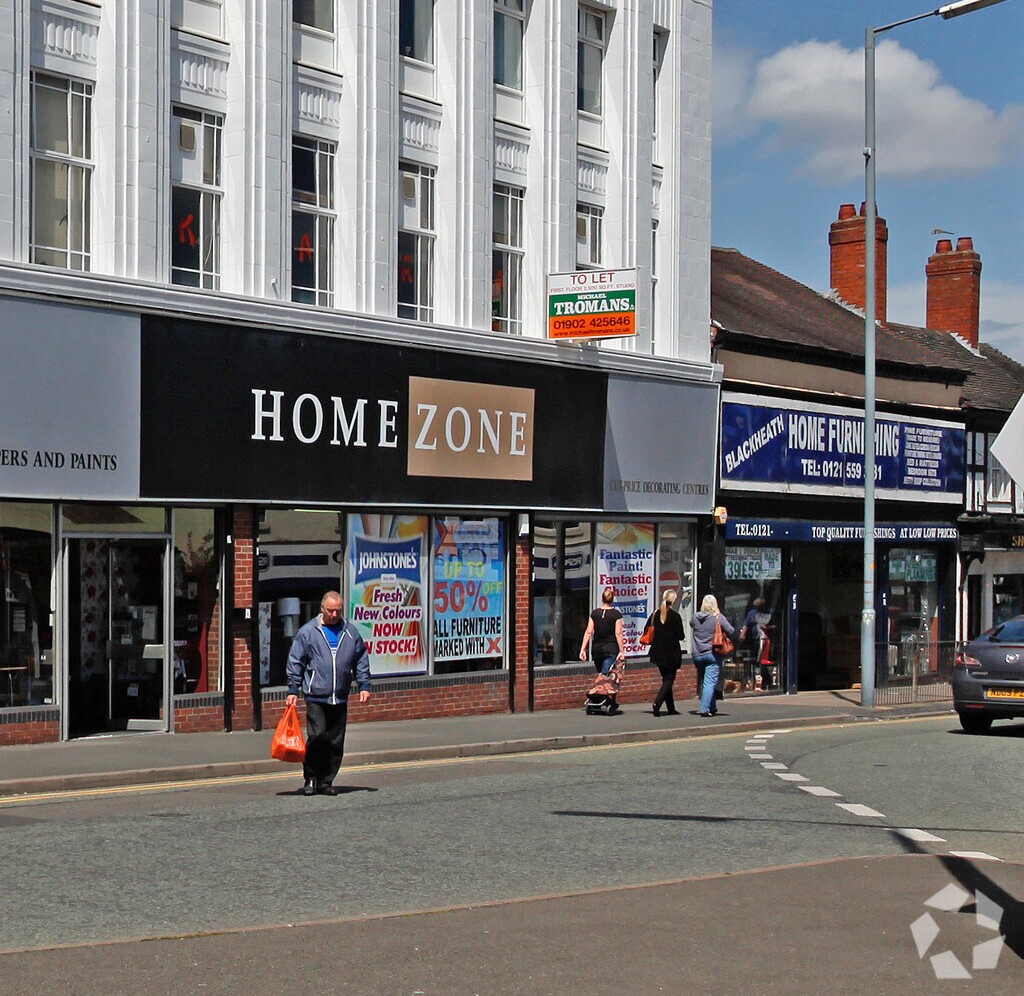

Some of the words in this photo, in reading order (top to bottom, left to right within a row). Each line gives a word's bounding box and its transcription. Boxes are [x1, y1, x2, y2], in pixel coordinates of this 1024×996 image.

[570, 274, 587, 285] TO
[592, 272, 615, 284] LET
[553, 319, 586, 330] 01902
[590, 316, 631, 328] 425646
[251, 388, 398, 448] HOME
[414, 403, 526, 456] ZONE
[725, 414, 785, 473] BLACKHEATH
[788, 414, 825, 452] HOME
[828, 418, 899, 458] FURNIHING
[33, 451, 65, 468] AND
[71, 453, 117, 471] PAINTS
[801, 459, 821, 477] TEL:
[822, 460, 842, 477] 0121
[846, 462, 862, 479] 559
[643, 481, 681, 494] DECORATING
[683, 483, 709, 495] CENTRES
[812, 527, 825, 538] TOP
[826, 526, 854, 541] QUALITY
[855, 527, 896, 539] FUSHINGS
[900, 528, 909, 538] AT
[909, 528, 922, 538] LOW
[923, 528, 936, 538] LOW
[937, 528, 957, 539] PRICES
[358, 547, 417, 574] JOHNSTONE'S
[600, 549, 653, 560] Fantastic
[444, 560, 462, 579] UP
[467, 560, 486, 578] TO
[609, 560, 643, 572] Paint!
[599, 574, 652, 585] Fantastic
[373, 588, 403, 603] Fresh
[434, 579, 488, 613] 50%
[483, 582, 503, 595] OFF
[354, 606, 379, 621] New
[382, 605, 421, 620] Colours
[620, 603, 646, 614] STONE'S
[373, 622, 404, 637] NOW
[434, 619, 449, 638] ALL
[451, 617, 501, 637] FURNITURE
[376, 637, 417, 655] STOCK!
[465, 637, 485, 656] WITH
